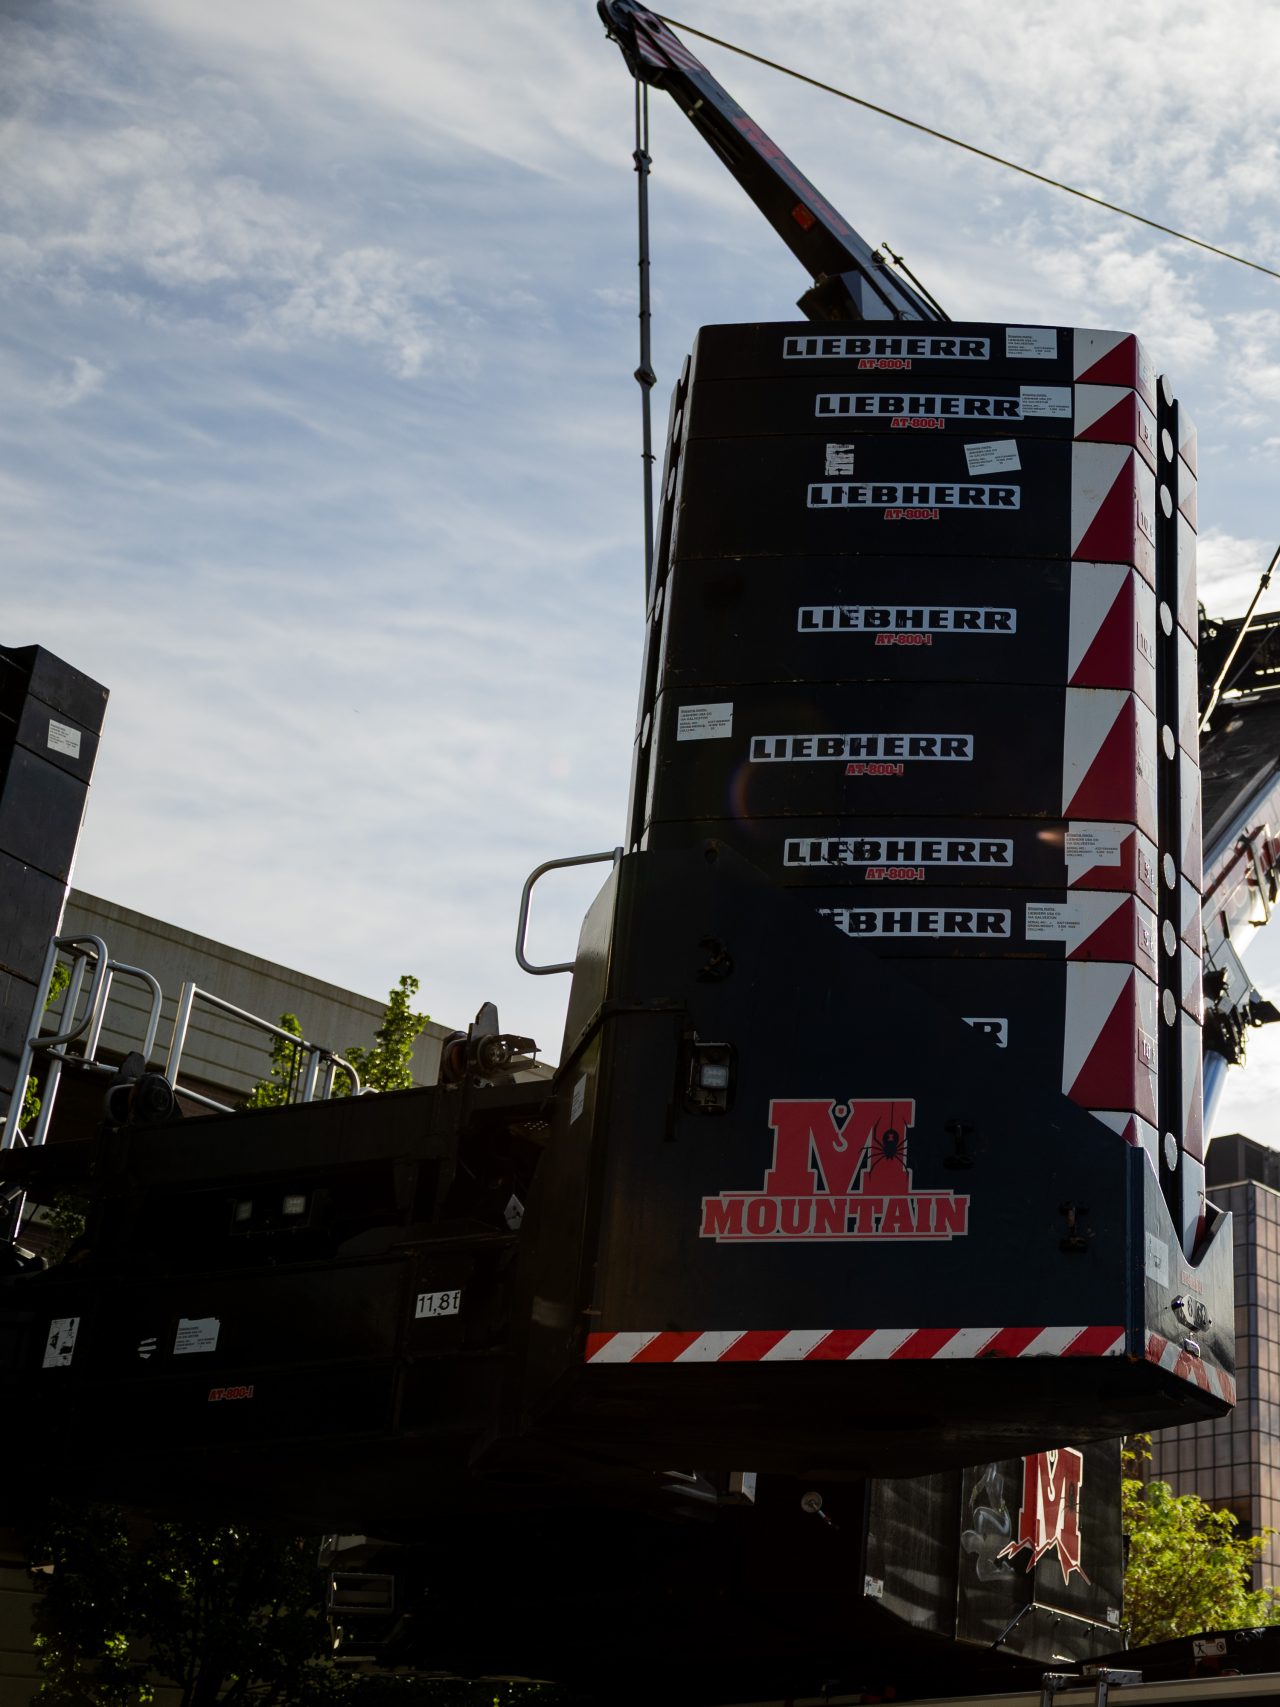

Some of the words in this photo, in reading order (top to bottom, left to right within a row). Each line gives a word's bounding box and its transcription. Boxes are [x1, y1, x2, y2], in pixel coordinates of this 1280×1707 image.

[786, 338, 986, 357] LIEBHERR
[818, 396, 1021, 417] LIEBHERR
[810, 486, 1017, 506] LIEBHERR
[801, 609, 1013, 630] LIEBHERR
[753, 737, 969, 759] LIEBHERR
[787, 841, 1009, 863] LIEBHERR
[833, 911, 1007, 934] BHERR
[764, 1098, 915, 1195] M
[702, 1196, 970, 1235] MOUNTAIN
